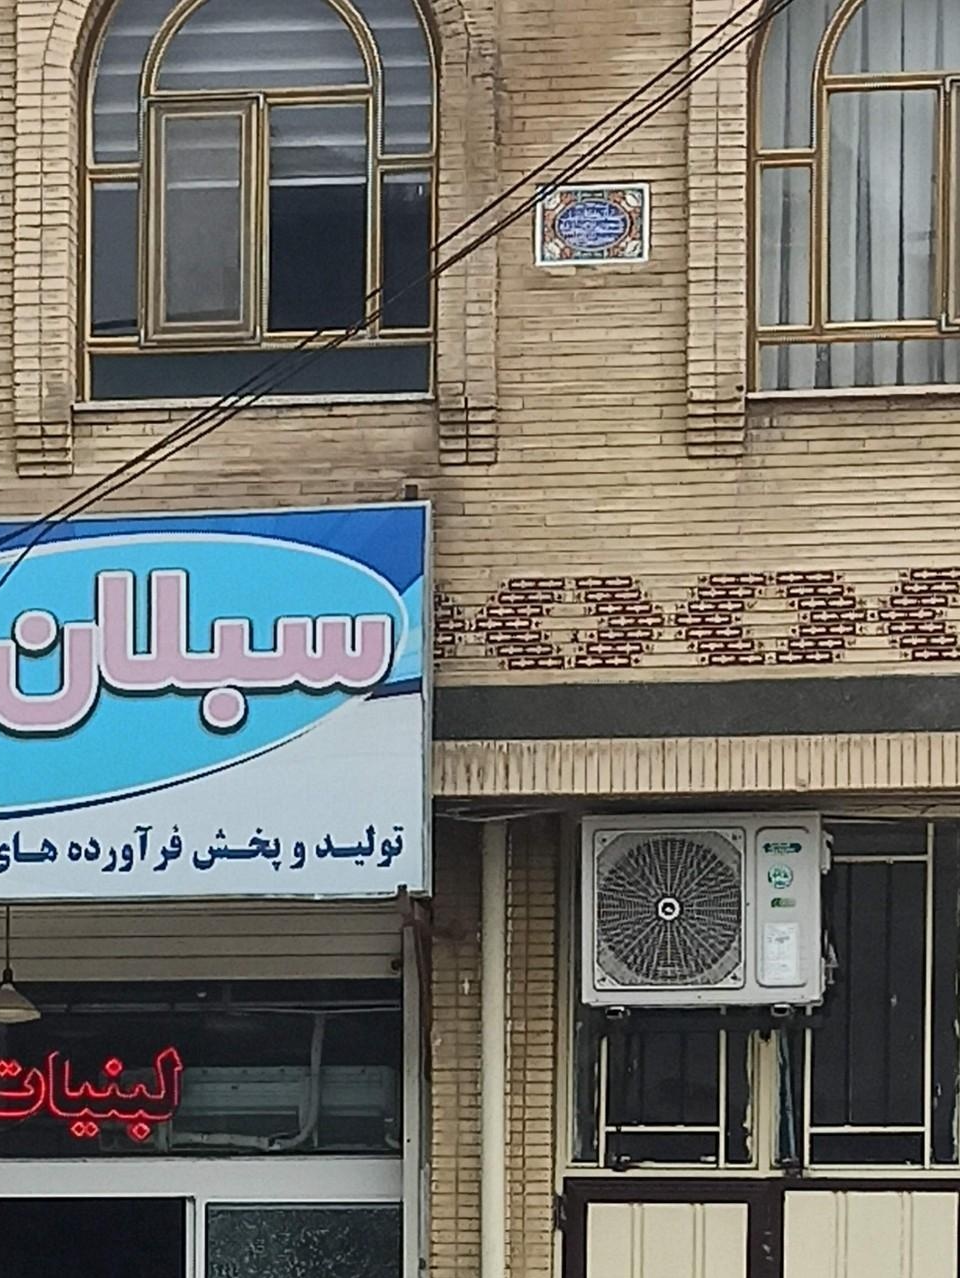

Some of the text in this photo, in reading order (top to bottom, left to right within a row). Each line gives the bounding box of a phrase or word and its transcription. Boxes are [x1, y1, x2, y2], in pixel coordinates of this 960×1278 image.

[193, 828, 281, 871] پخش
[289, 840, 306, 869] و
[315, 824, 404, 868] تولید
